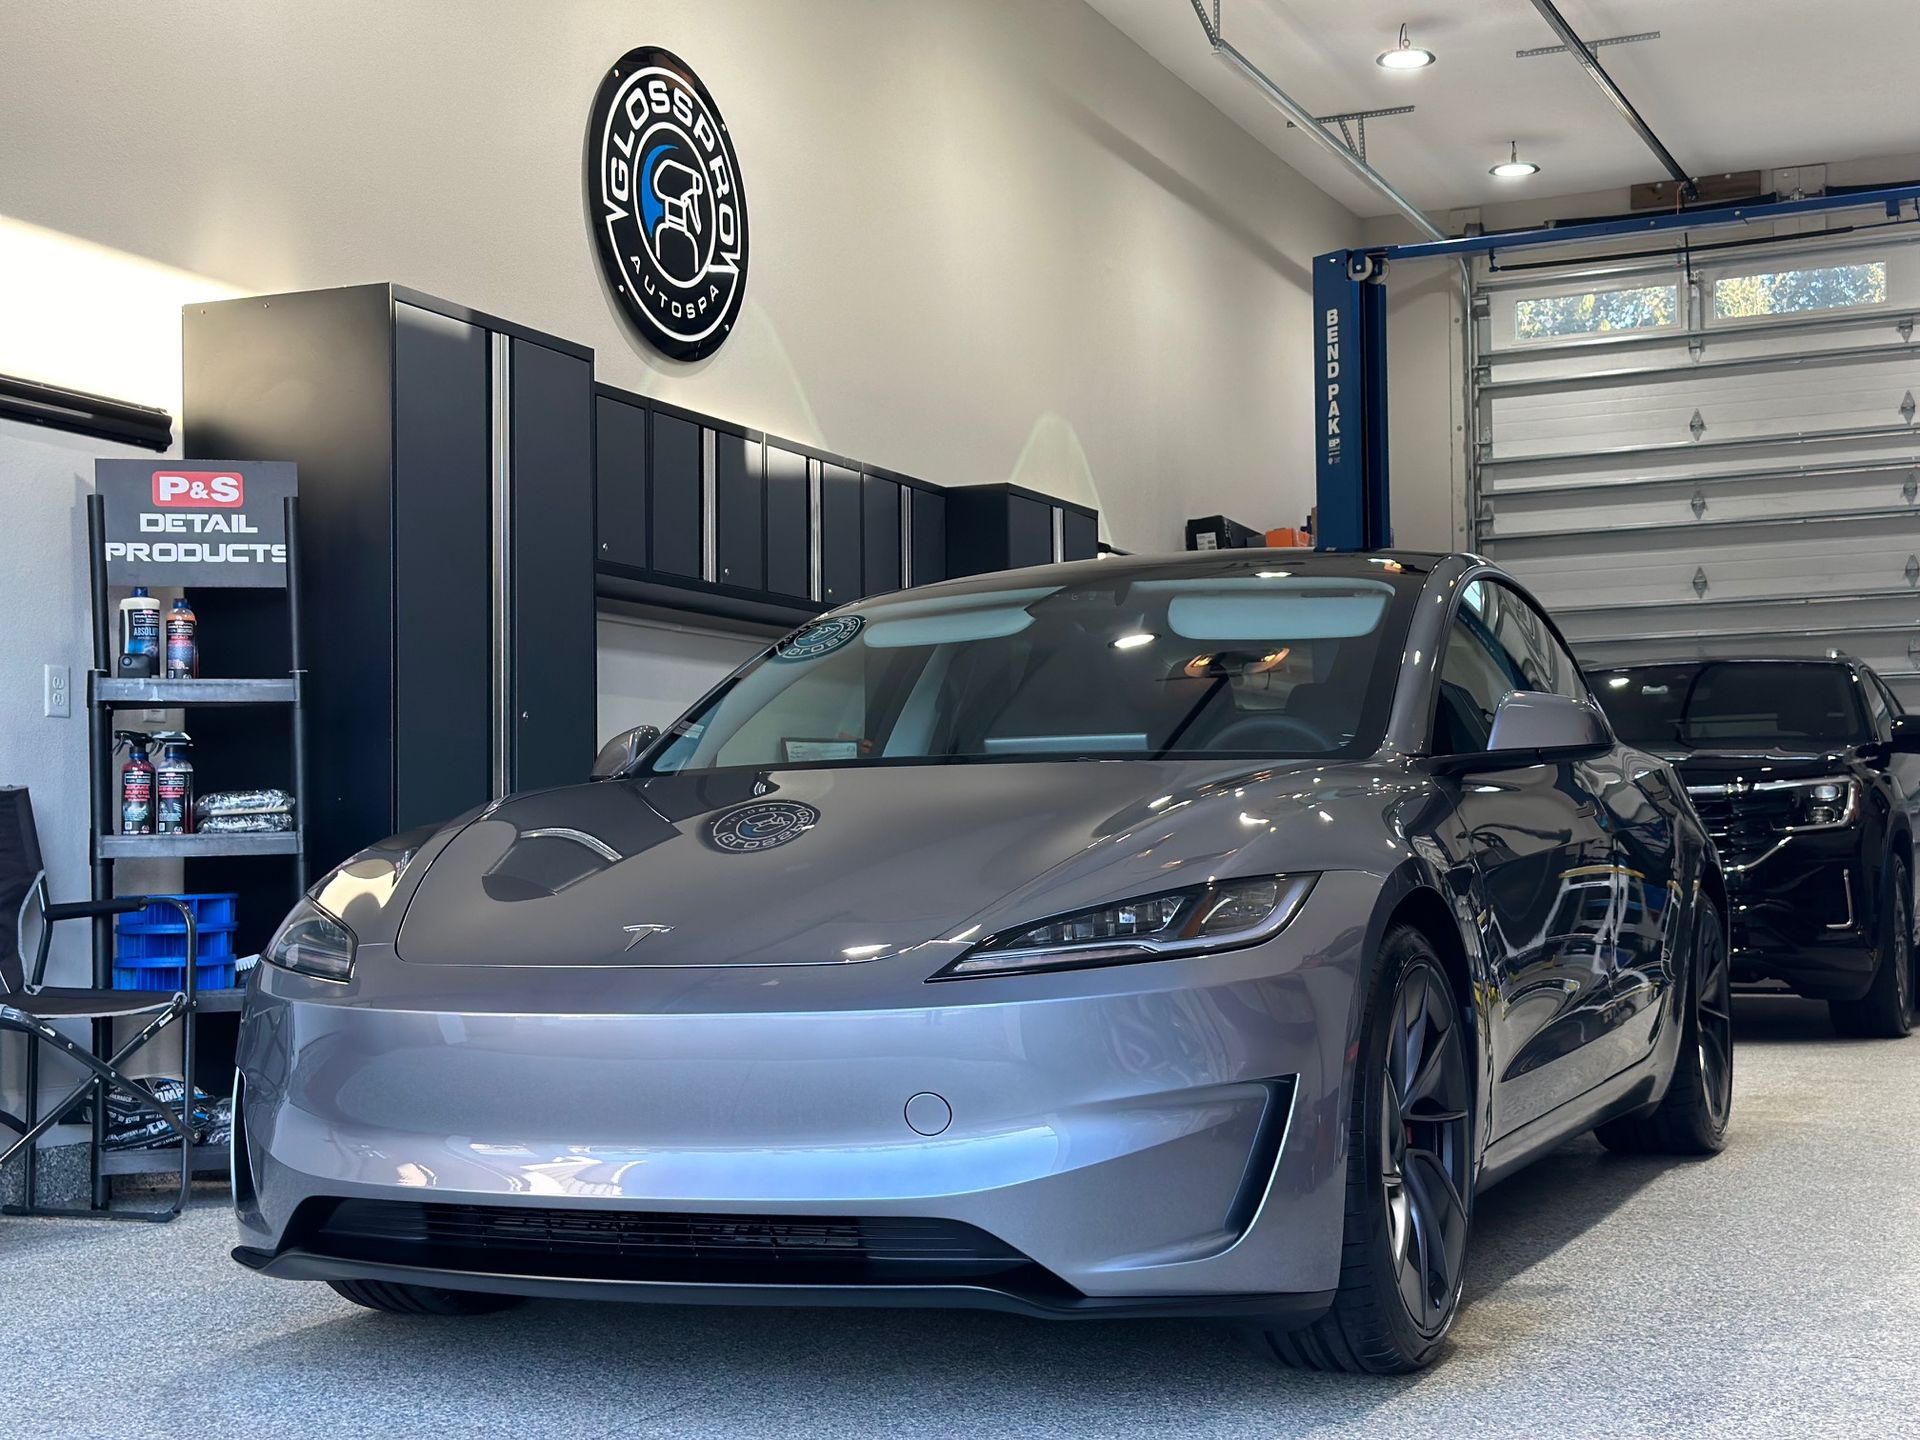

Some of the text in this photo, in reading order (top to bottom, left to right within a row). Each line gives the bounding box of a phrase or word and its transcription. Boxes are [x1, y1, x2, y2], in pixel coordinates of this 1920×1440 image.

[611, 80, 734, 247] GLOSSPRO
[629, 255, 719, 319] AUTOSPA
[159, 476, 239, 502] P&S
[140, 513, 258, 533] DETAIL
[104, 542, 287, 563] PRODUCTS
